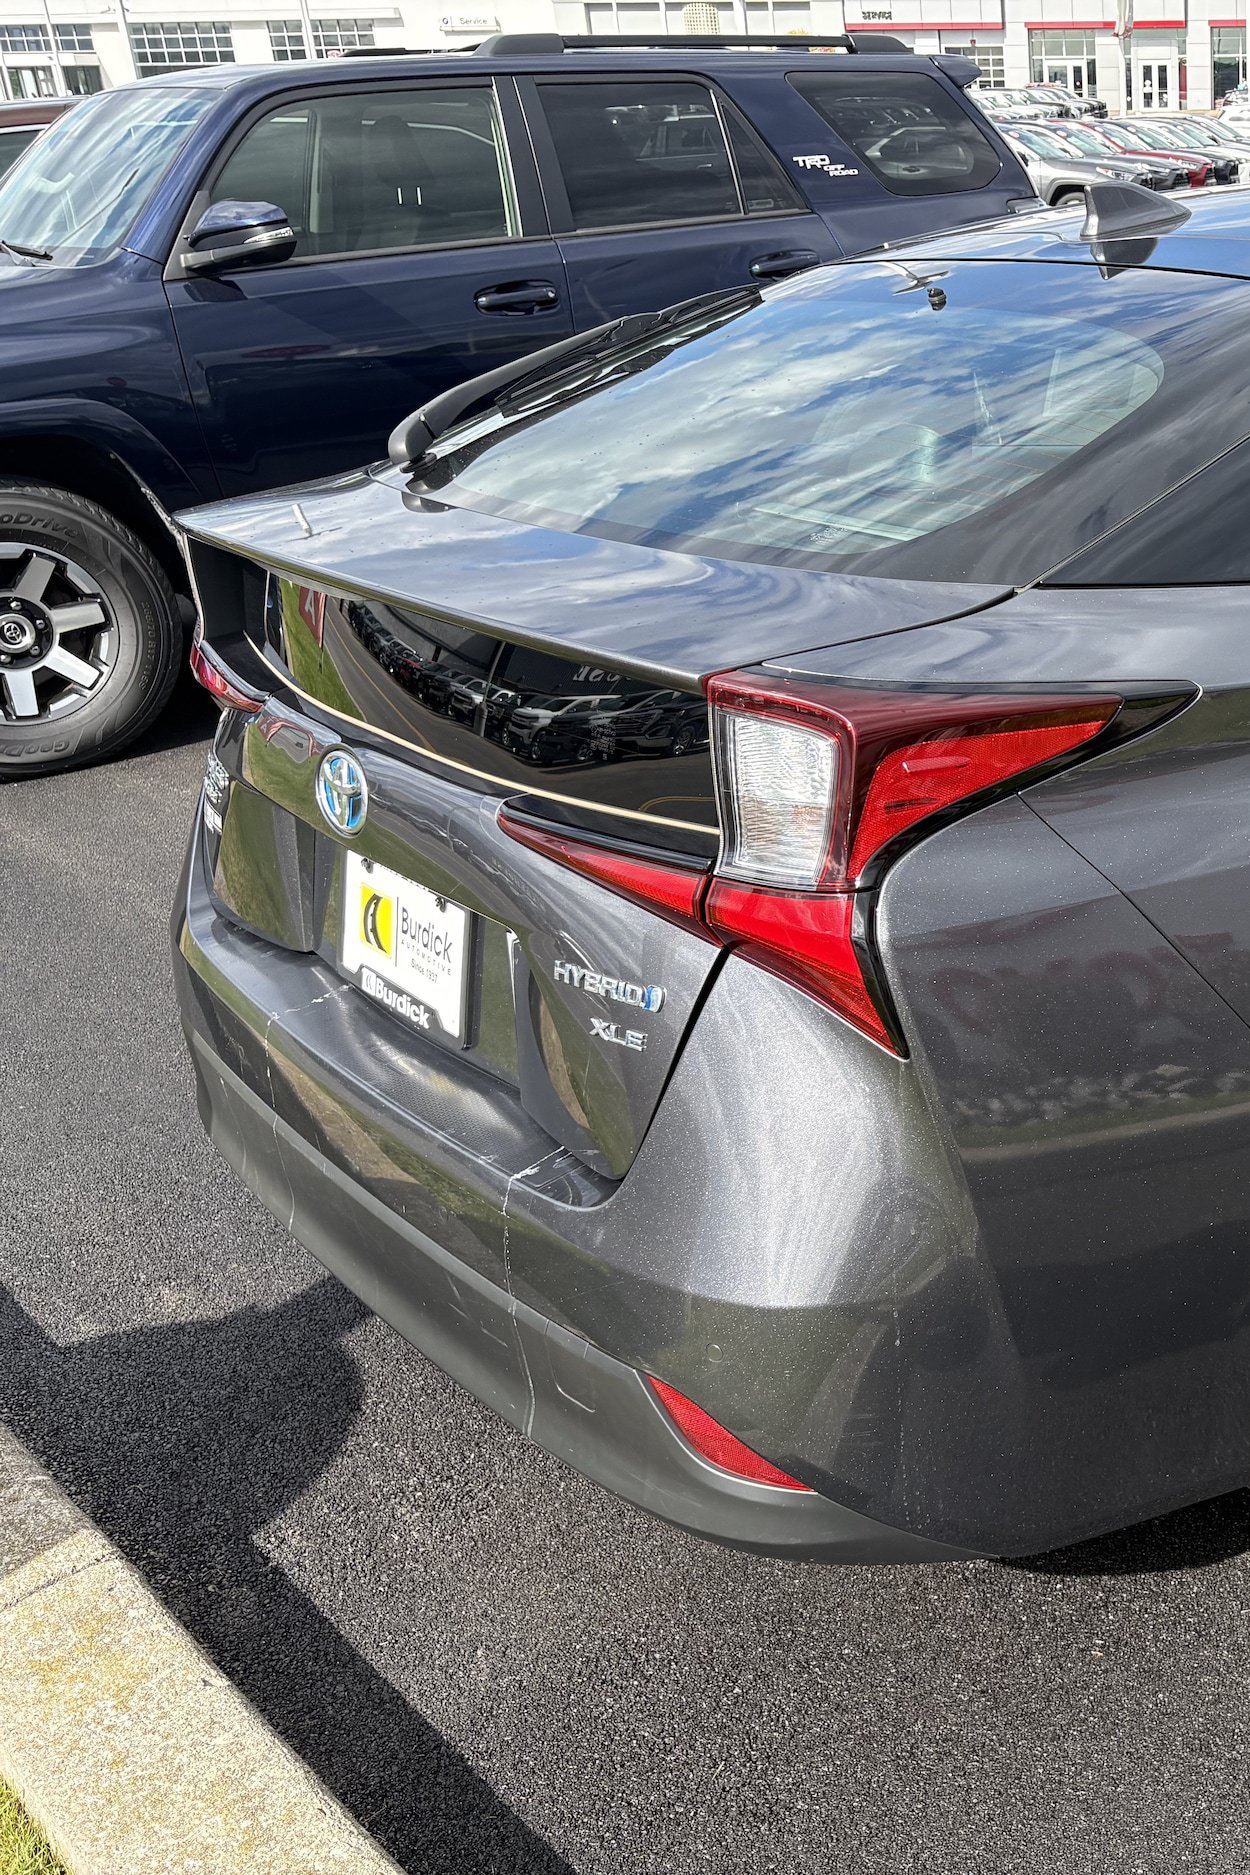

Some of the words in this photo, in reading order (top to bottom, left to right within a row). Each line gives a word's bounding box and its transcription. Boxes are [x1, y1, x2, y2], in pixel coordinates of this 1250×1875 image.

[459, 17, 488, 25] Service
[792, 154, 830, 169] TRD
[829, 169, 859, 177] ROAD
[401, 906, 453, 963] Burdick
[401, 939, 451, 976] AUTOMOTIVE
[411, 958, 424, 975] Since
[553, 960, 645, 1008] HYBRID
[375, 980, 430, 1030] Burdick
[589, 1017, 648, 1052] XLE
